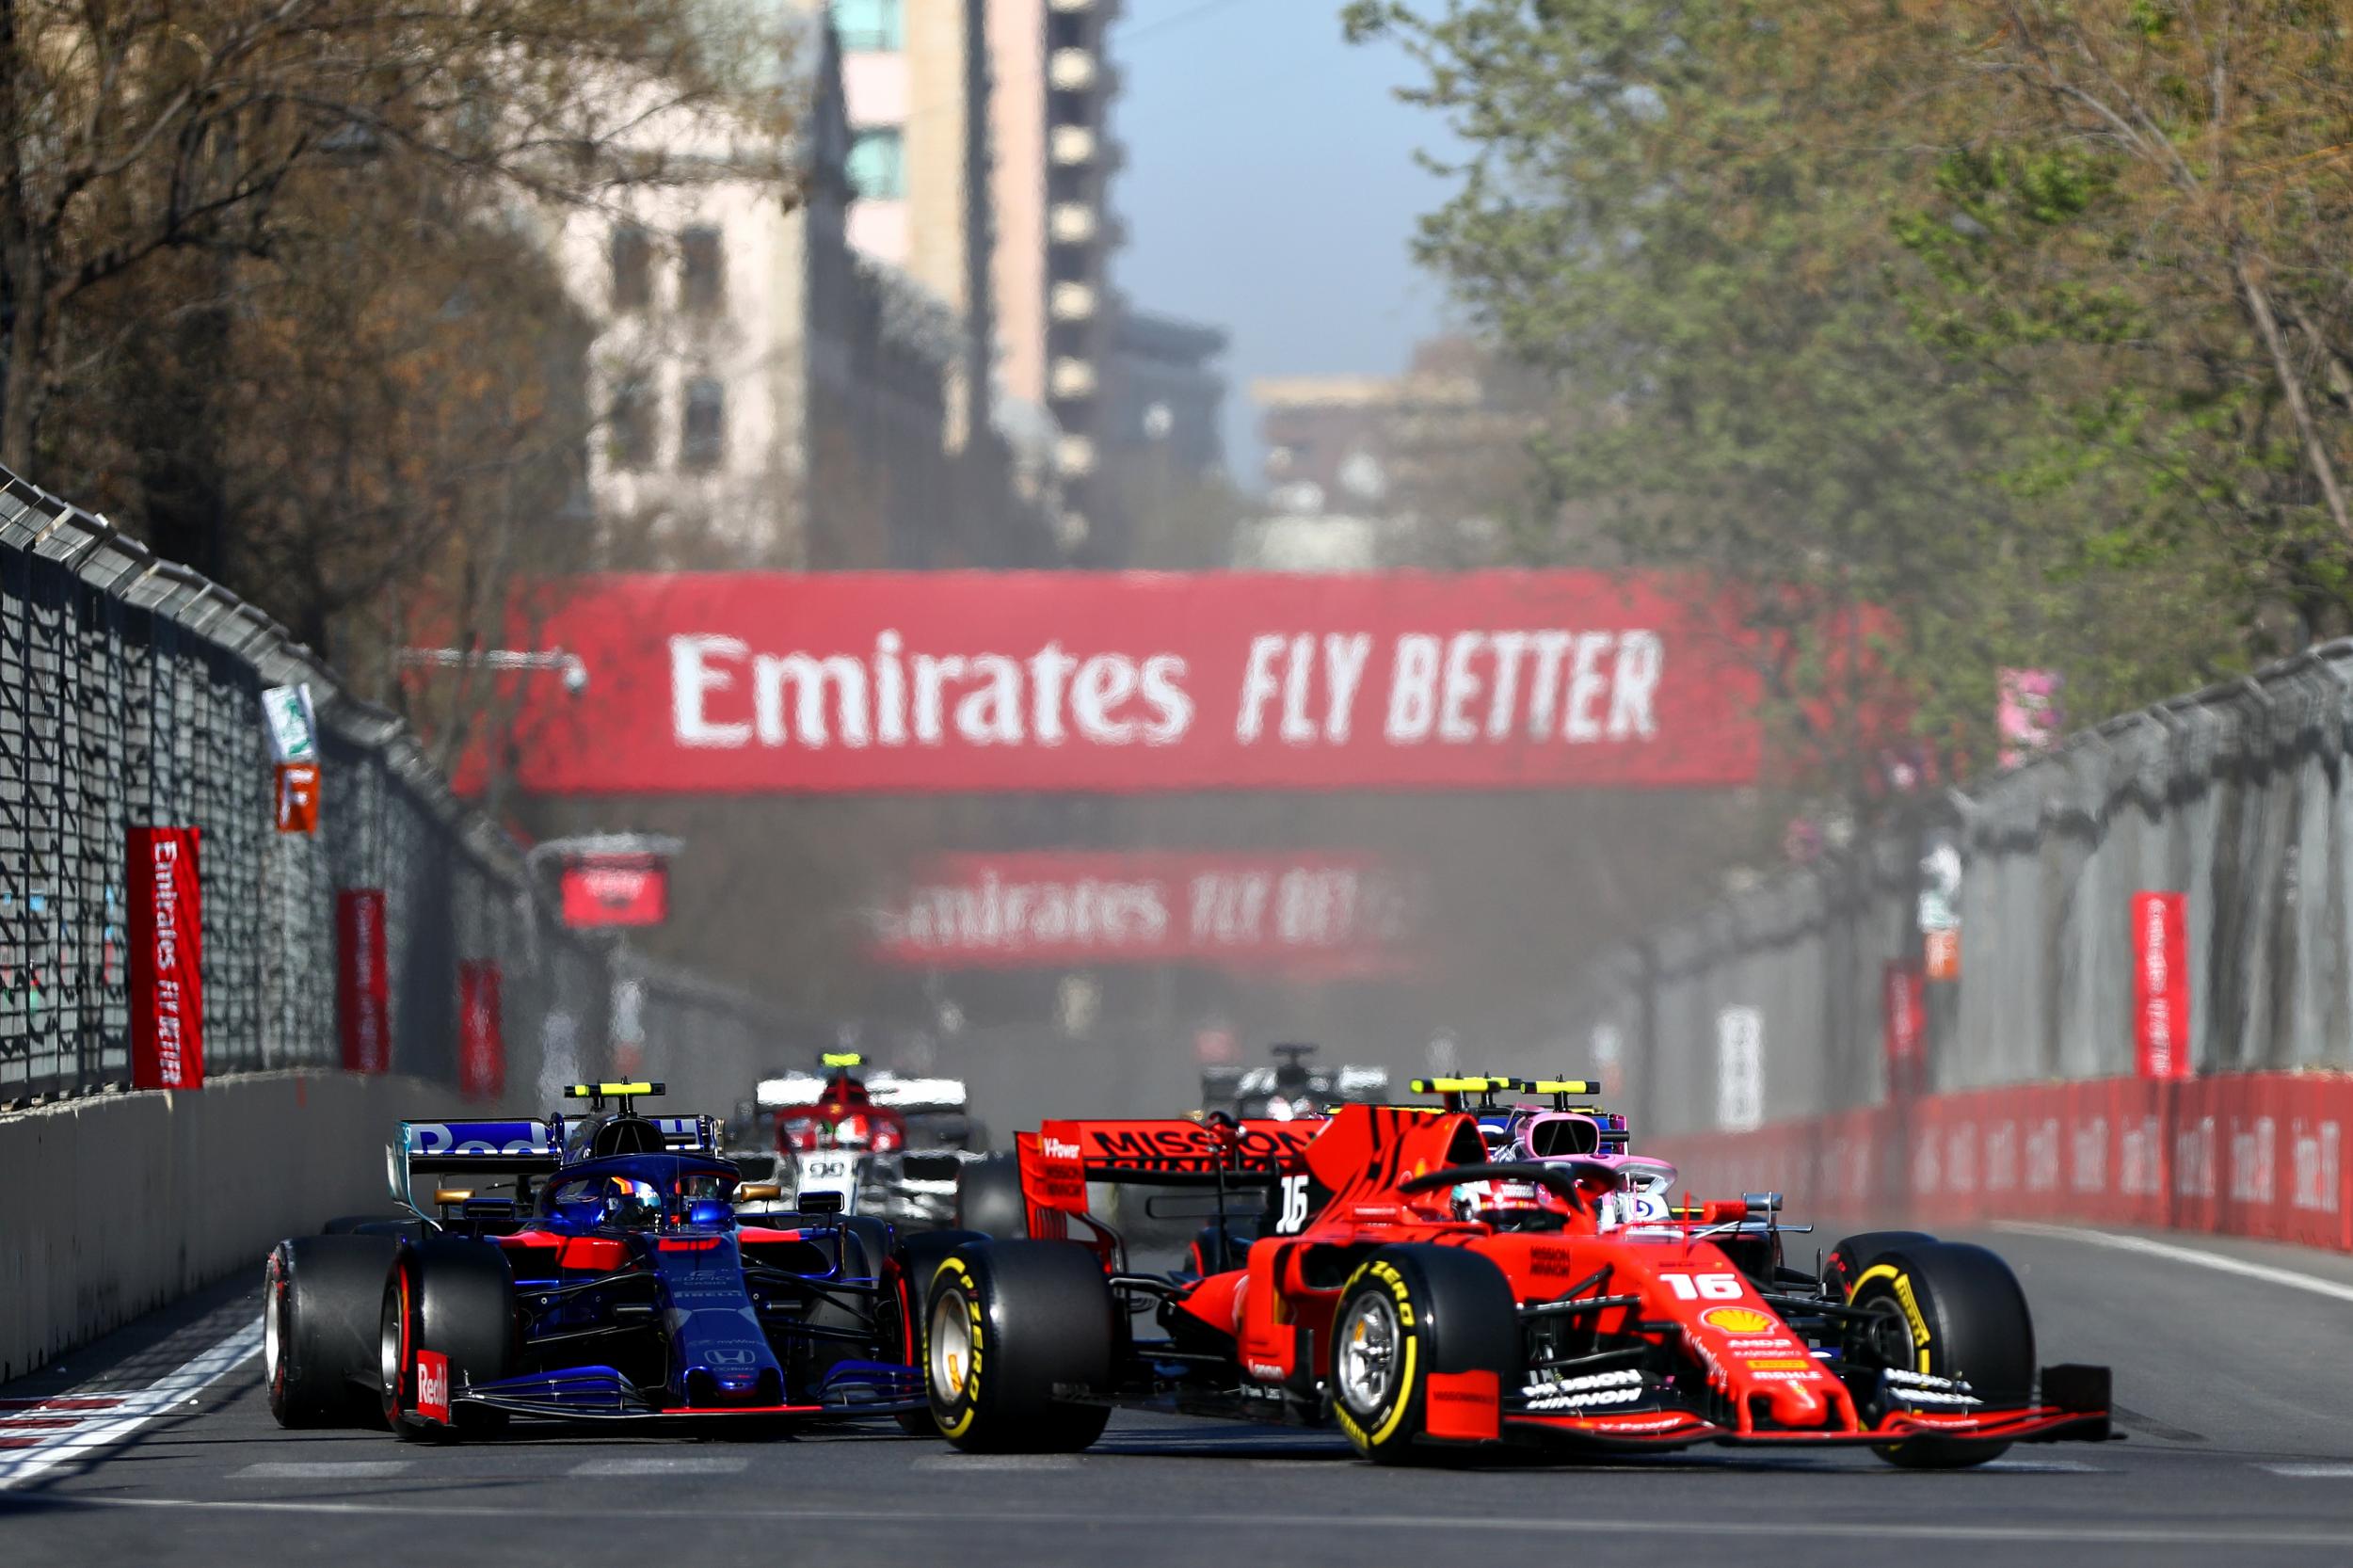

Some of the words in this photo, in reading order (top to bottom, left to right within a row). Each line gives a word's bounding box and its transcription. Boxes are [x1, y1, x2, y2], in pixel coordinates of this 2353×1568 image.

[669, 628, 1193, 749] Emirates
[1236, 632, 1371, 744] FLY
[1384, 629, 1664, 744] BETTER
[280, 769, 314, 825] F
[154, 840, 178, 971] Emirates
[1043, 1137, 1080, 1160] V-Power
[1276, 1175, 1309, 1234] 16
[1529, 1245, 1571, 1261] MISSION
[1369, 1260, 1417, 1326] ZERO
[1658, 1272, 1744, 1300] 16
[968, 1301, 984, 1402] ZERO
[1751, 1370, 1823, 1381] MAHLE
[1527, 1387, 1642, 1410] WINNOW
[1599, 1416, 1682, 1432] V-Power
